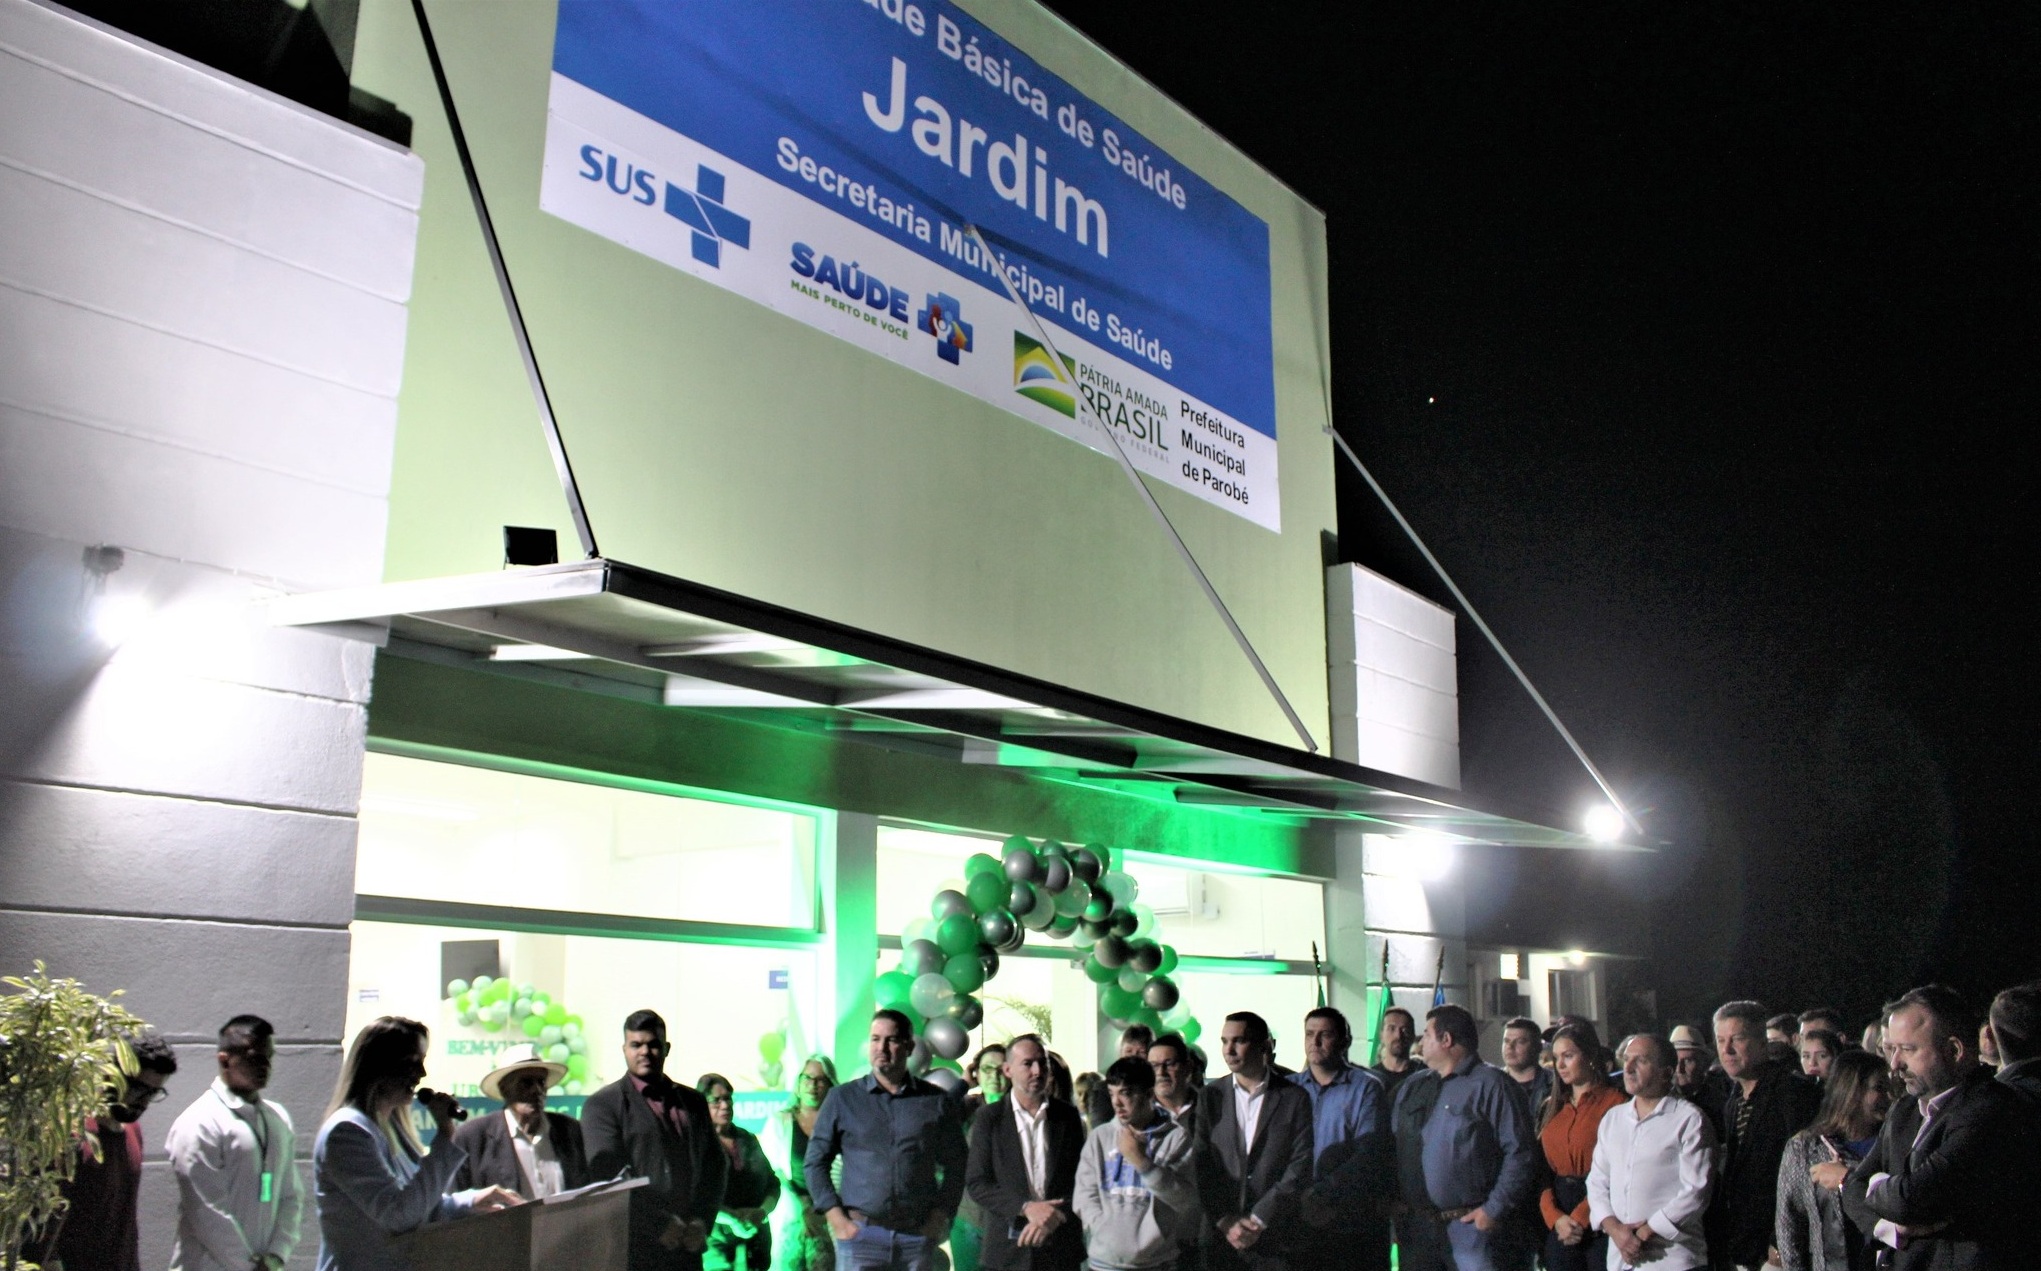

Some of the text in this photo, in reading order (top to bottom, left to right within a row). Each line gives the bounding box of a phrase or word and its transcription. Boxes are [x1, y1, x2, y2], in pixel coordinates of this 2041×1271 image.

[937, 13, 1049, 121] Básica
[1057, 103, 1095, 148] de
[1102, 128, 1187, 210] Saúde
[579, 144, 657, 206] SUS
[862, 56, 1109, 258] Jardim
[776, 136, 931, 244] Secretaria
[1072, 298, 1101, 332] de
[1106, 312, 1173, 370] Saúde
[790, 241, 910, 324] SAÚDE
[791, 279, 910, 341] MAIS PERTO DE VOCÊ
[1080, 363, 1168, 421] PÁTRIA AMADA
[1181, 400, 1246, 449] Prefeitura
[1181, 428, 1246, 476] Municipal
[1182, 460, 1249, 505] de Parobé
